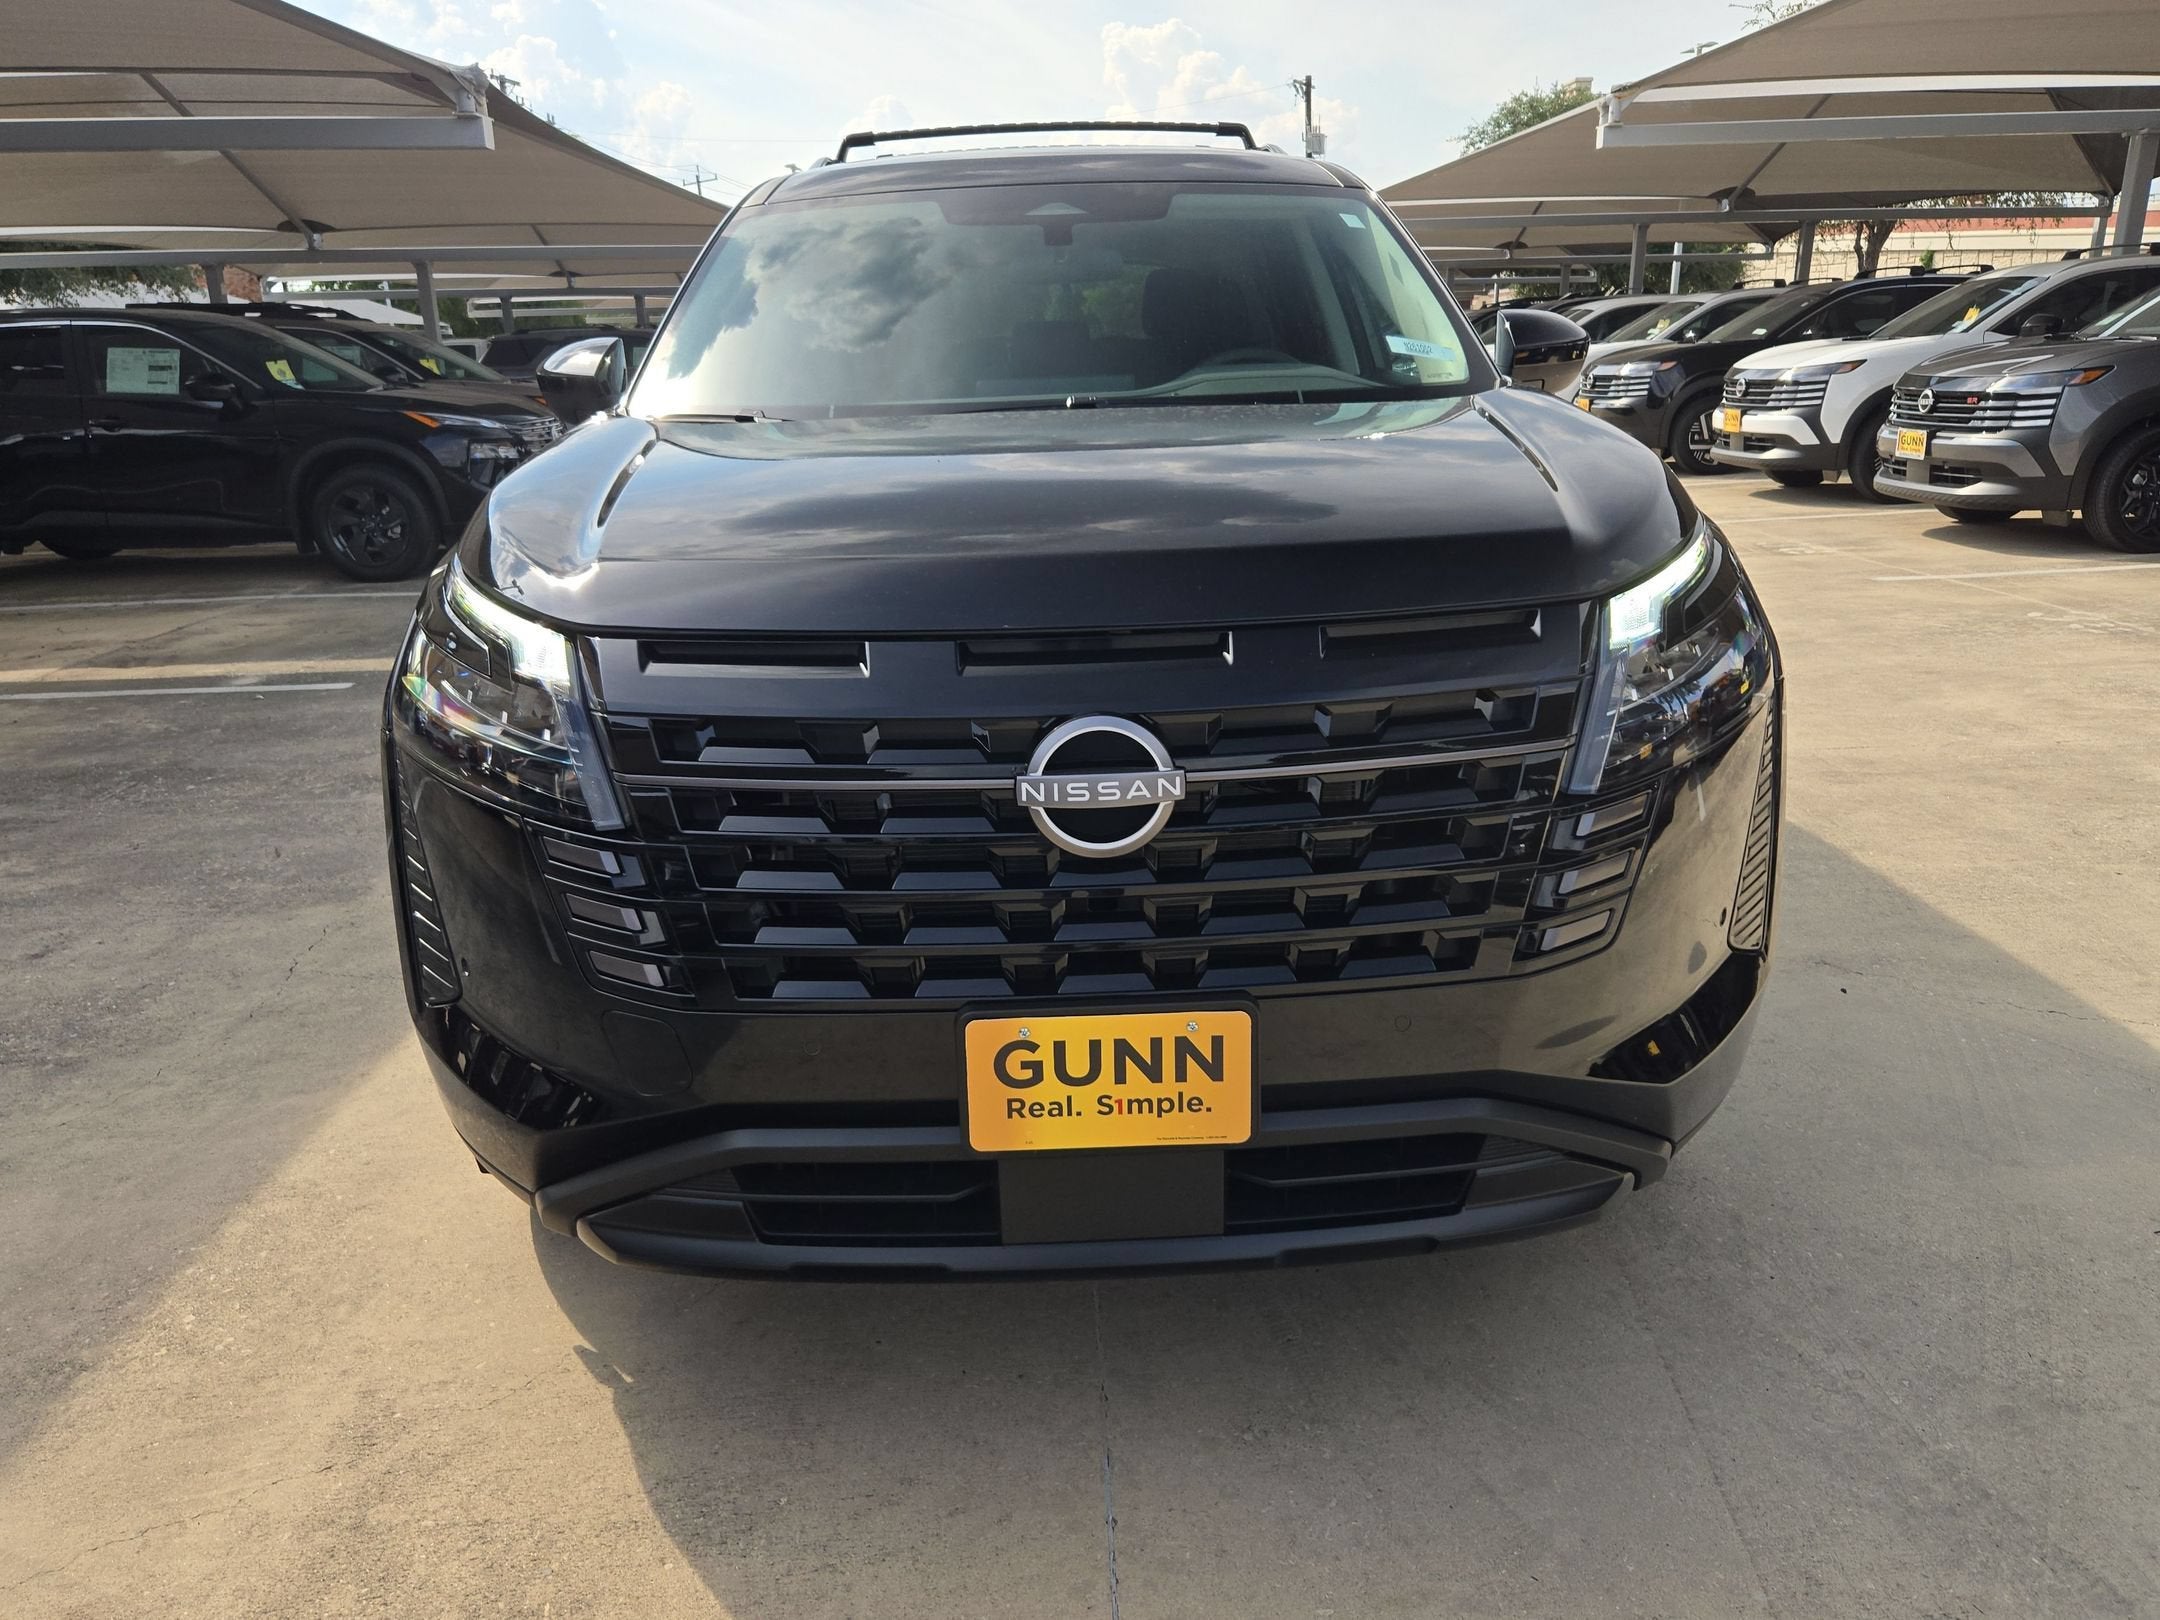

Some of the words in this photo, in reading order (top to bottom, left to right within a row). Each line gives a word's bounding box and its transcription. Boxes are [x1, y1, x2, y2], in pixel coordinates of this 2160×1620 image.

[1900, 434, 1924, 447] GUNN
[1020, 776, 1182, 802] NISSAN
[993, 1035, 1225, 1089] GUNN
[1006, 1095, 1082, 1120] Real.
